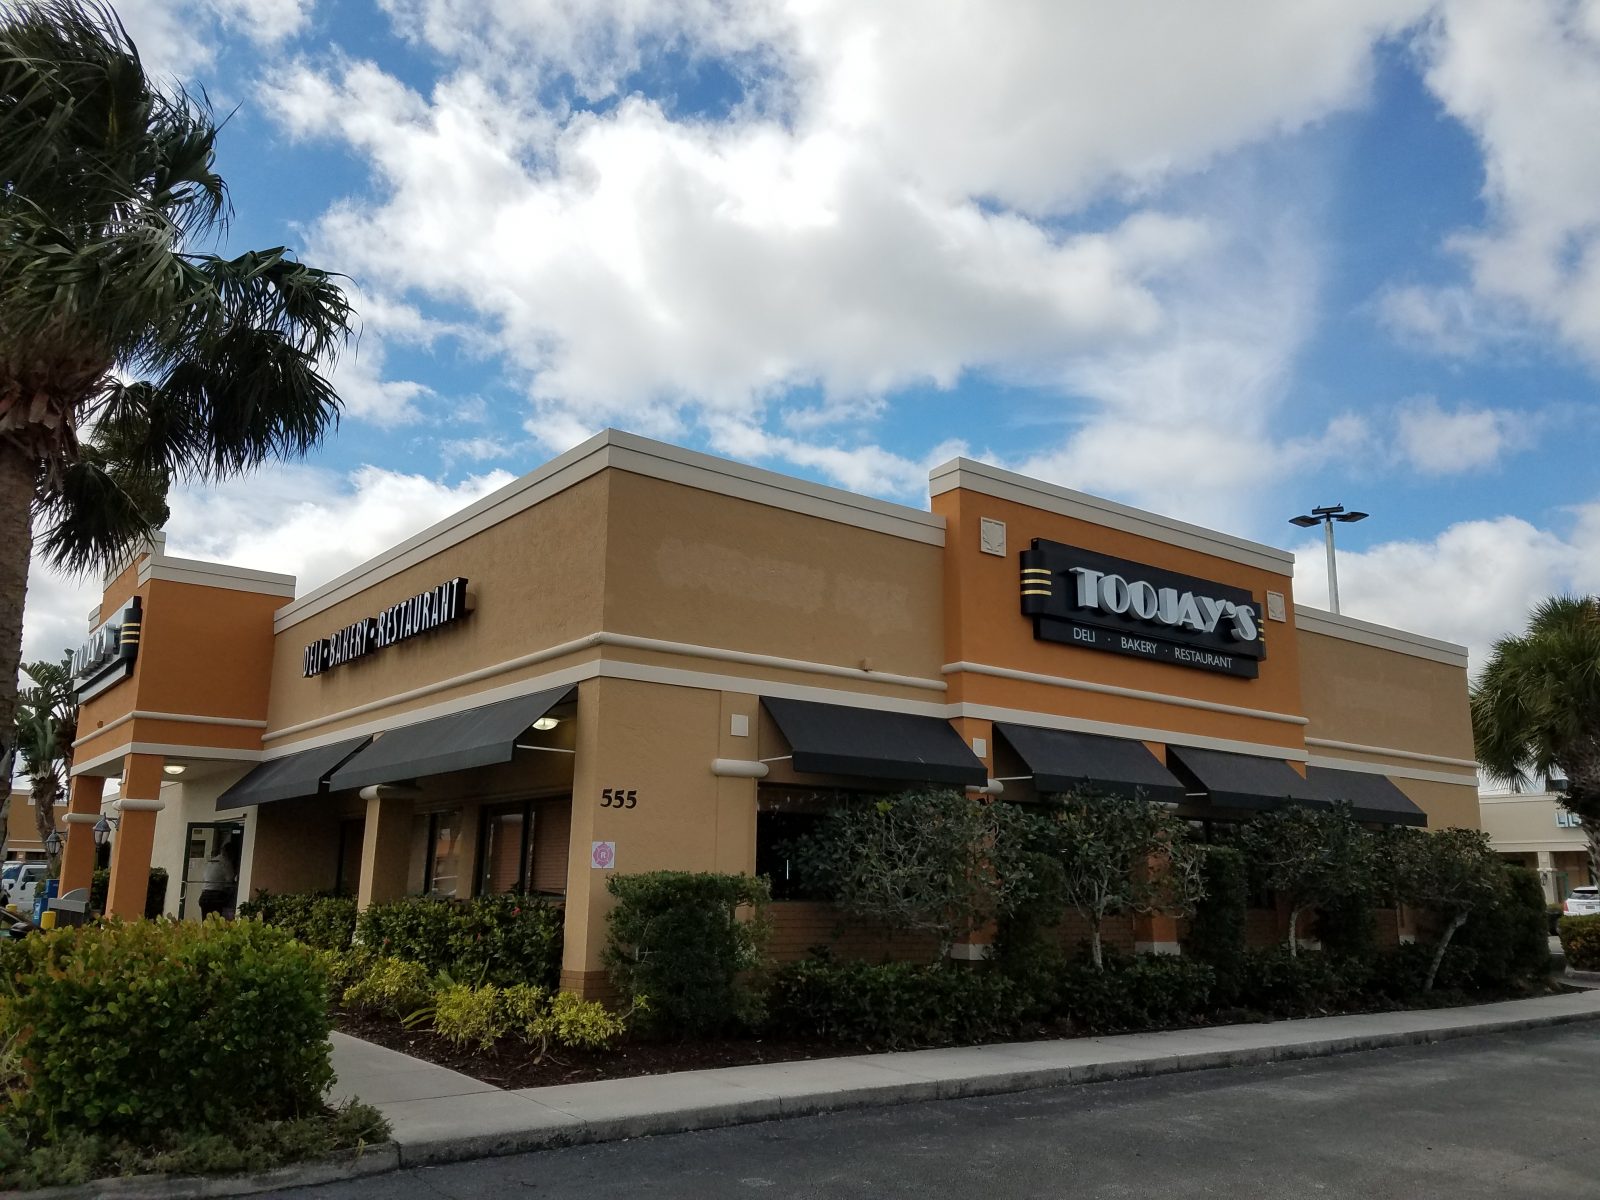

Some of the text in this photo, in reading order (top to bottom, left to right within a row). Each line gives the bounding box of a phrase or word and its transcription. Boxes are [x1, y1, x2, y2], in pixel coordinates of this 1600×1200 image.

[303, 578, 463, 678] DELI BAKERY RESTAURANT
[1069, 567, 1257, 641] TOOJAY'S
[1073, 627, 1233, 669] DELI BAKERY RESTAURANT
[600, 788, 637, 809] 555
